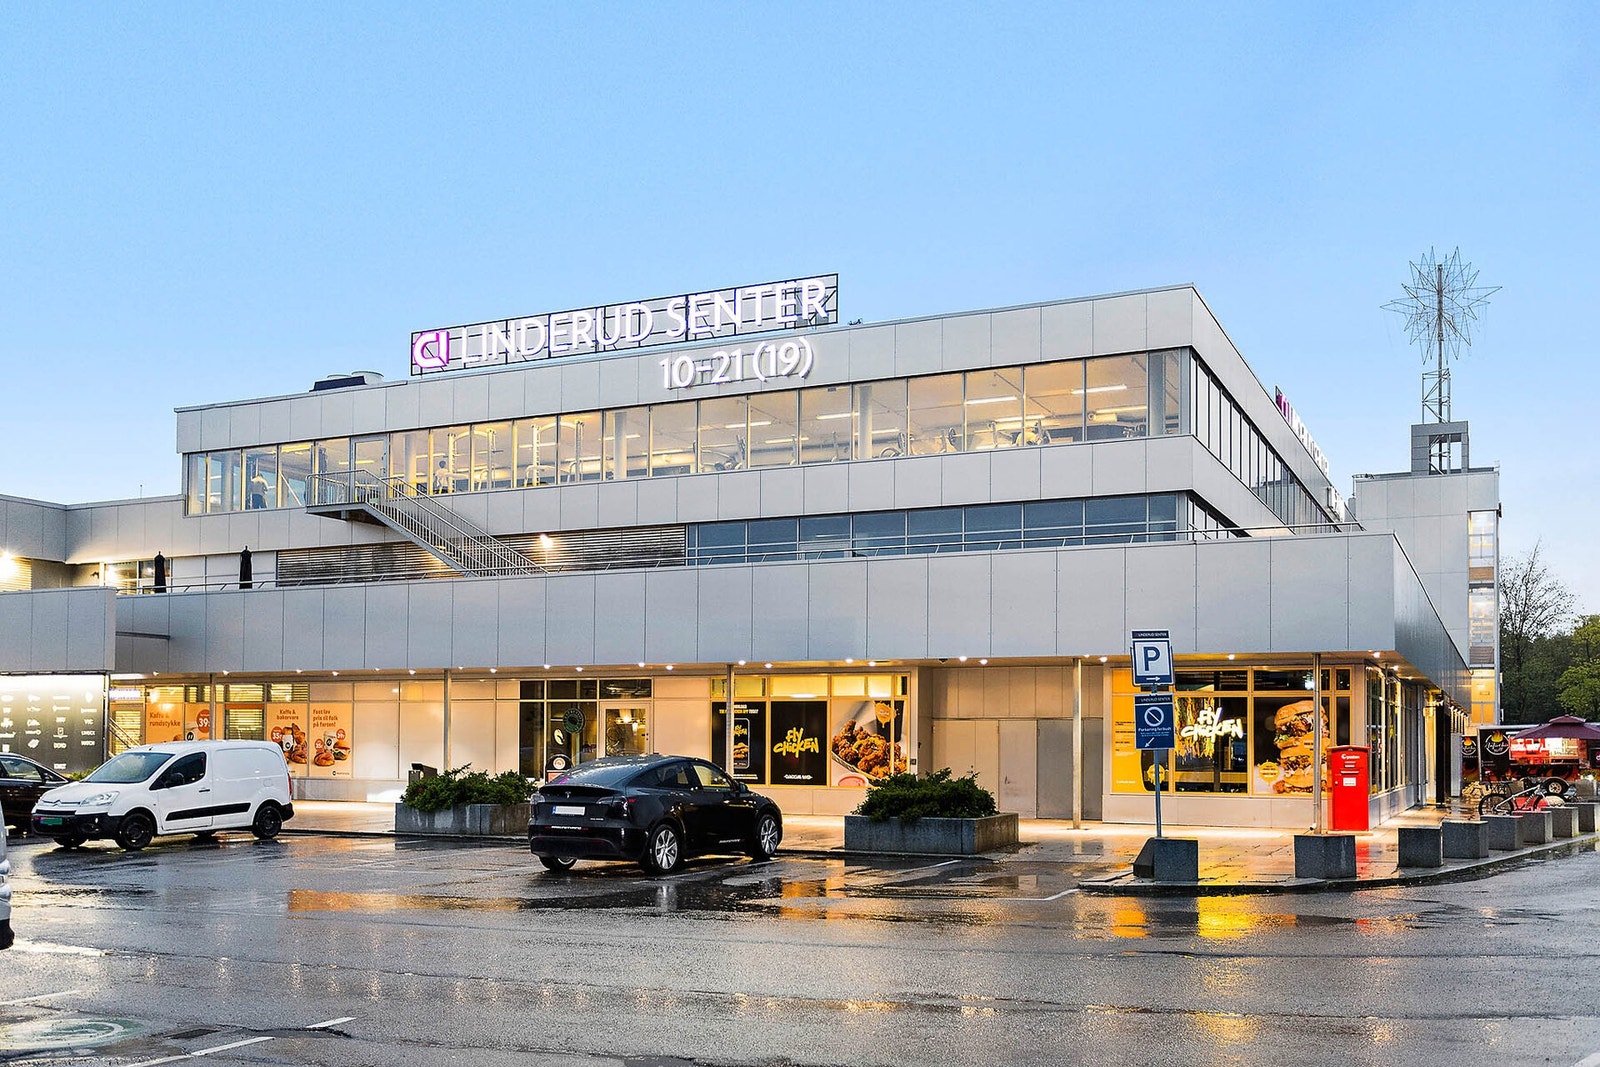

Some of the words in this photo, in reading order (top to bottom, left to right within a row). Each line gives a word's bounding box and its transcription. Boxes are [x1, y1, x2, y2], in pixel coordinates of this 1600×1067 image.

[461, 301, 654, 364] LINDERUD
[666, 278, 829, 339] SENTER
[753, 336, 814, 382] (19)
[1143, 646, 1160, 671] P
